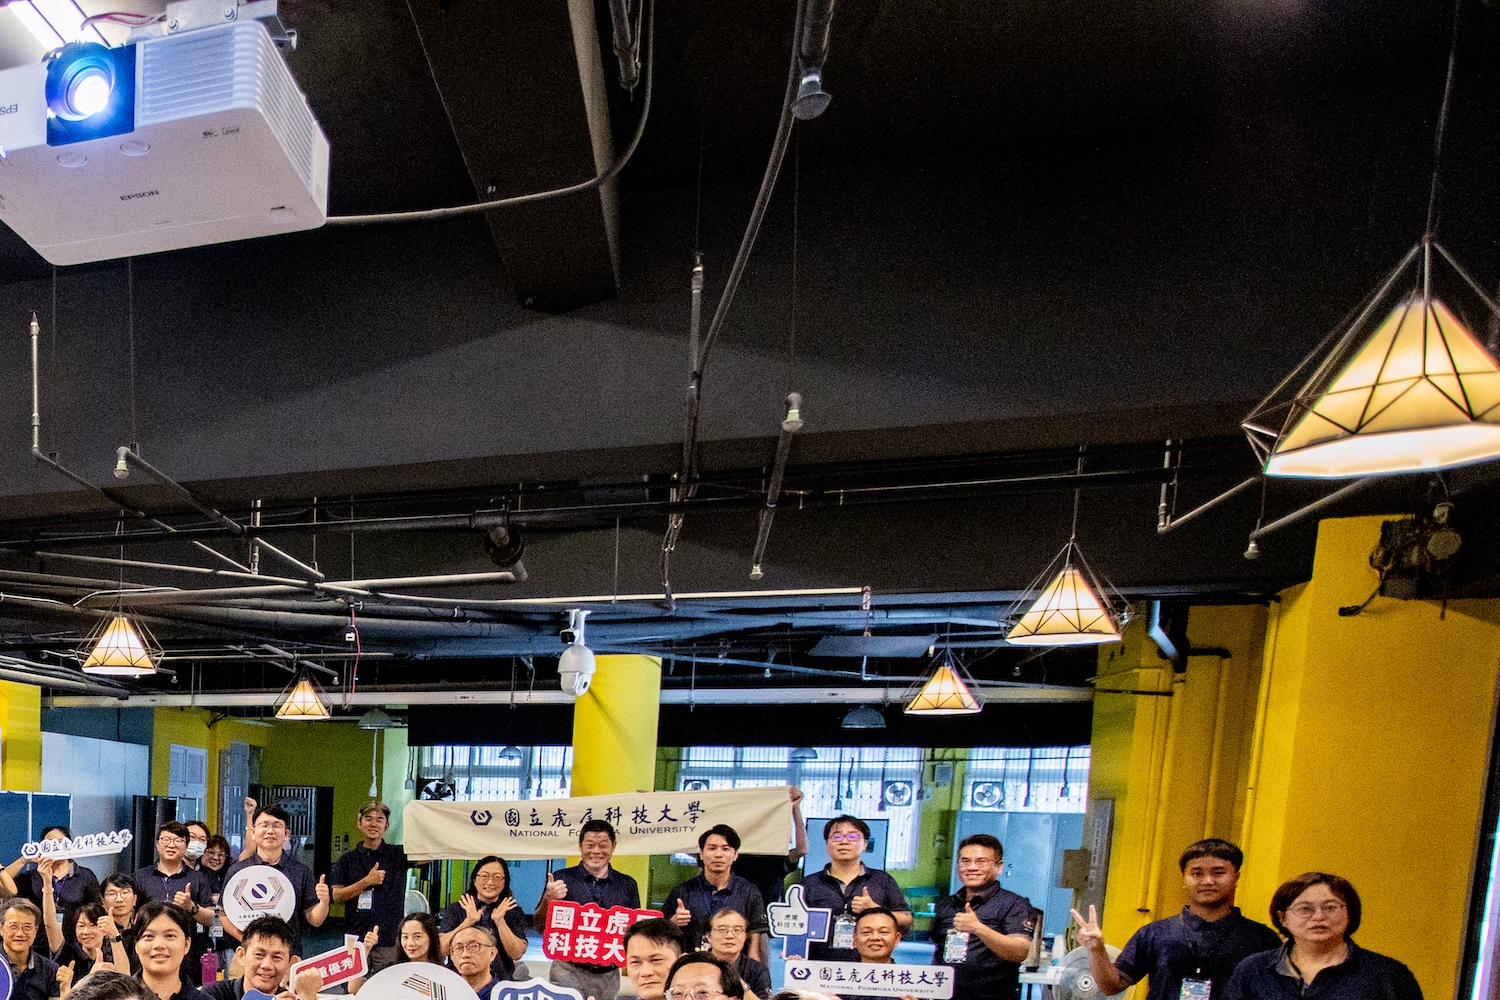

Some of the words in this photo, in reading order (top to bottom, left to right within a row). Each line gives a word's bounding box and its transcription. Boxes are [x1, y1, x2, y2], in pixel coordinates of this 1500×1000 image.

[120, 189, 159, 201] EPSON
[504, 800, 705, 828] 國立虎尾科技大學
[509, 829, 559, 837] NATIONAL
[629, 825, 696, 835] UNIVERSITY
[551, 905, 657, 935] 國立虎
[819, 967, 948, 988] 國立虎尾科技大學
